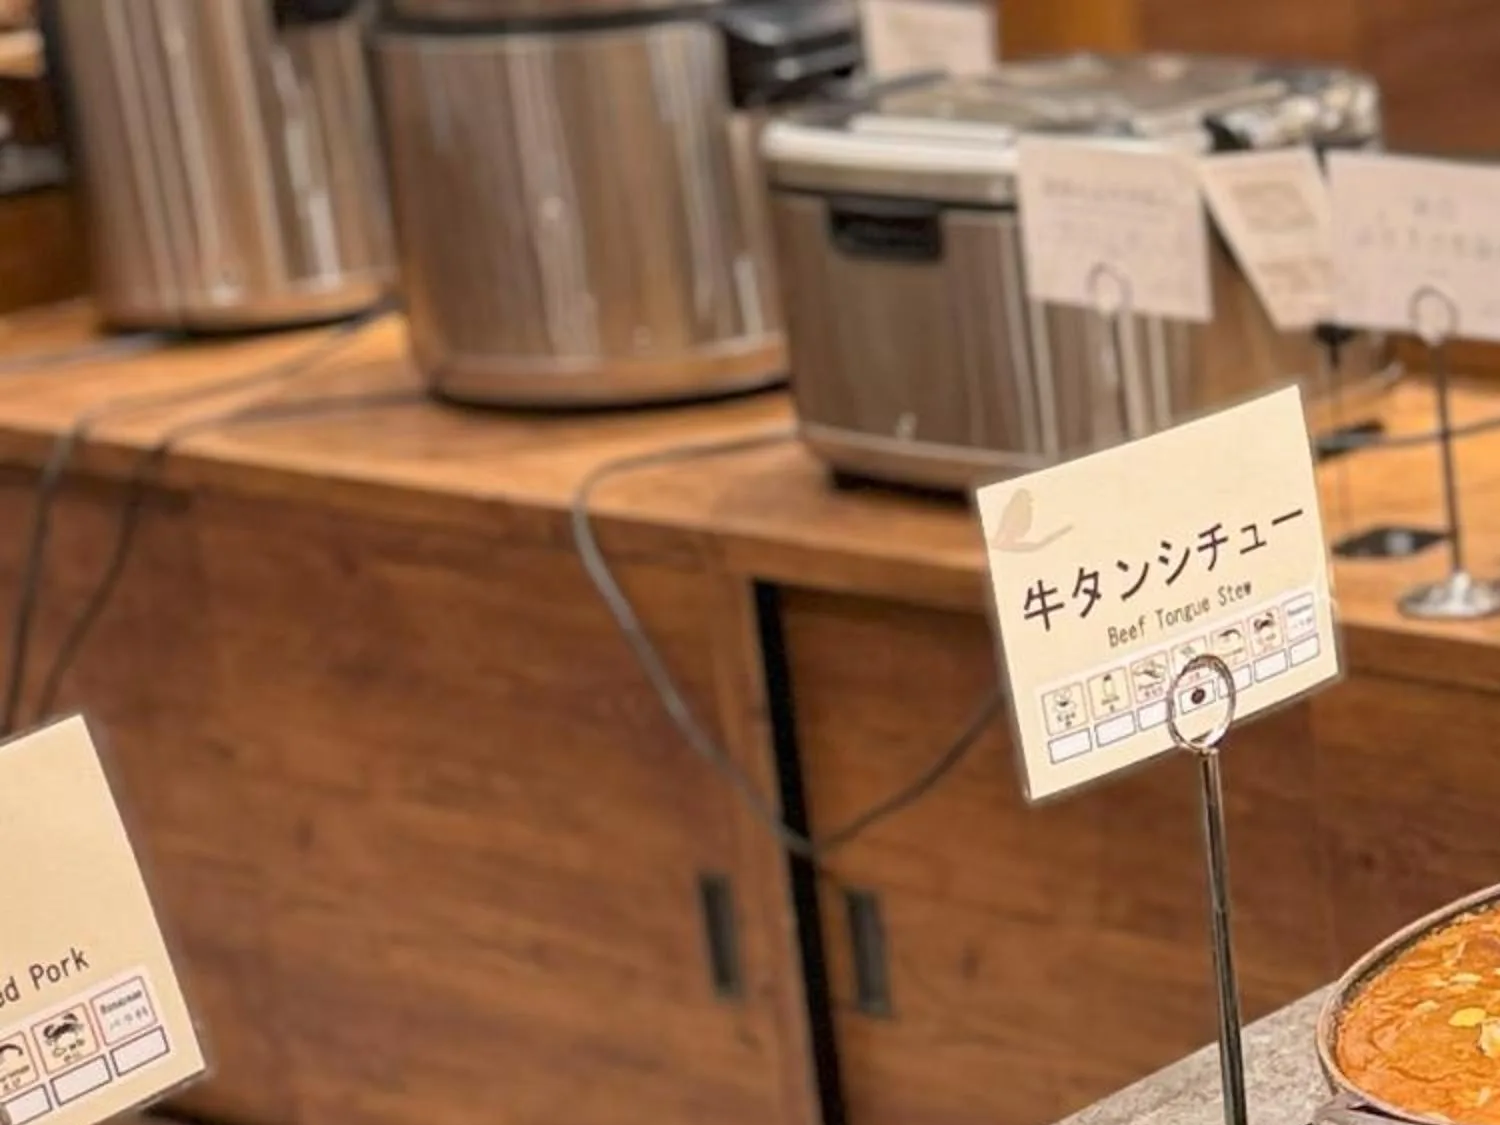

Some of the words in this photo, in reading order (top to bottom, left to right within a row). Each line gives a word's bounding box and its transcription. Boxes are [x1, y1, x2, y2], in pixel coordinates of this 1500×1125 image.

[1022, 507, 1304, 632] 牛タンシチュー
[1106, 614, 1147, 648] Beef
[1153, 597, 1211, 631] Tongue
[1217, 580, 1252, 607] Stew
[28, 947, 90, 992] Pork
